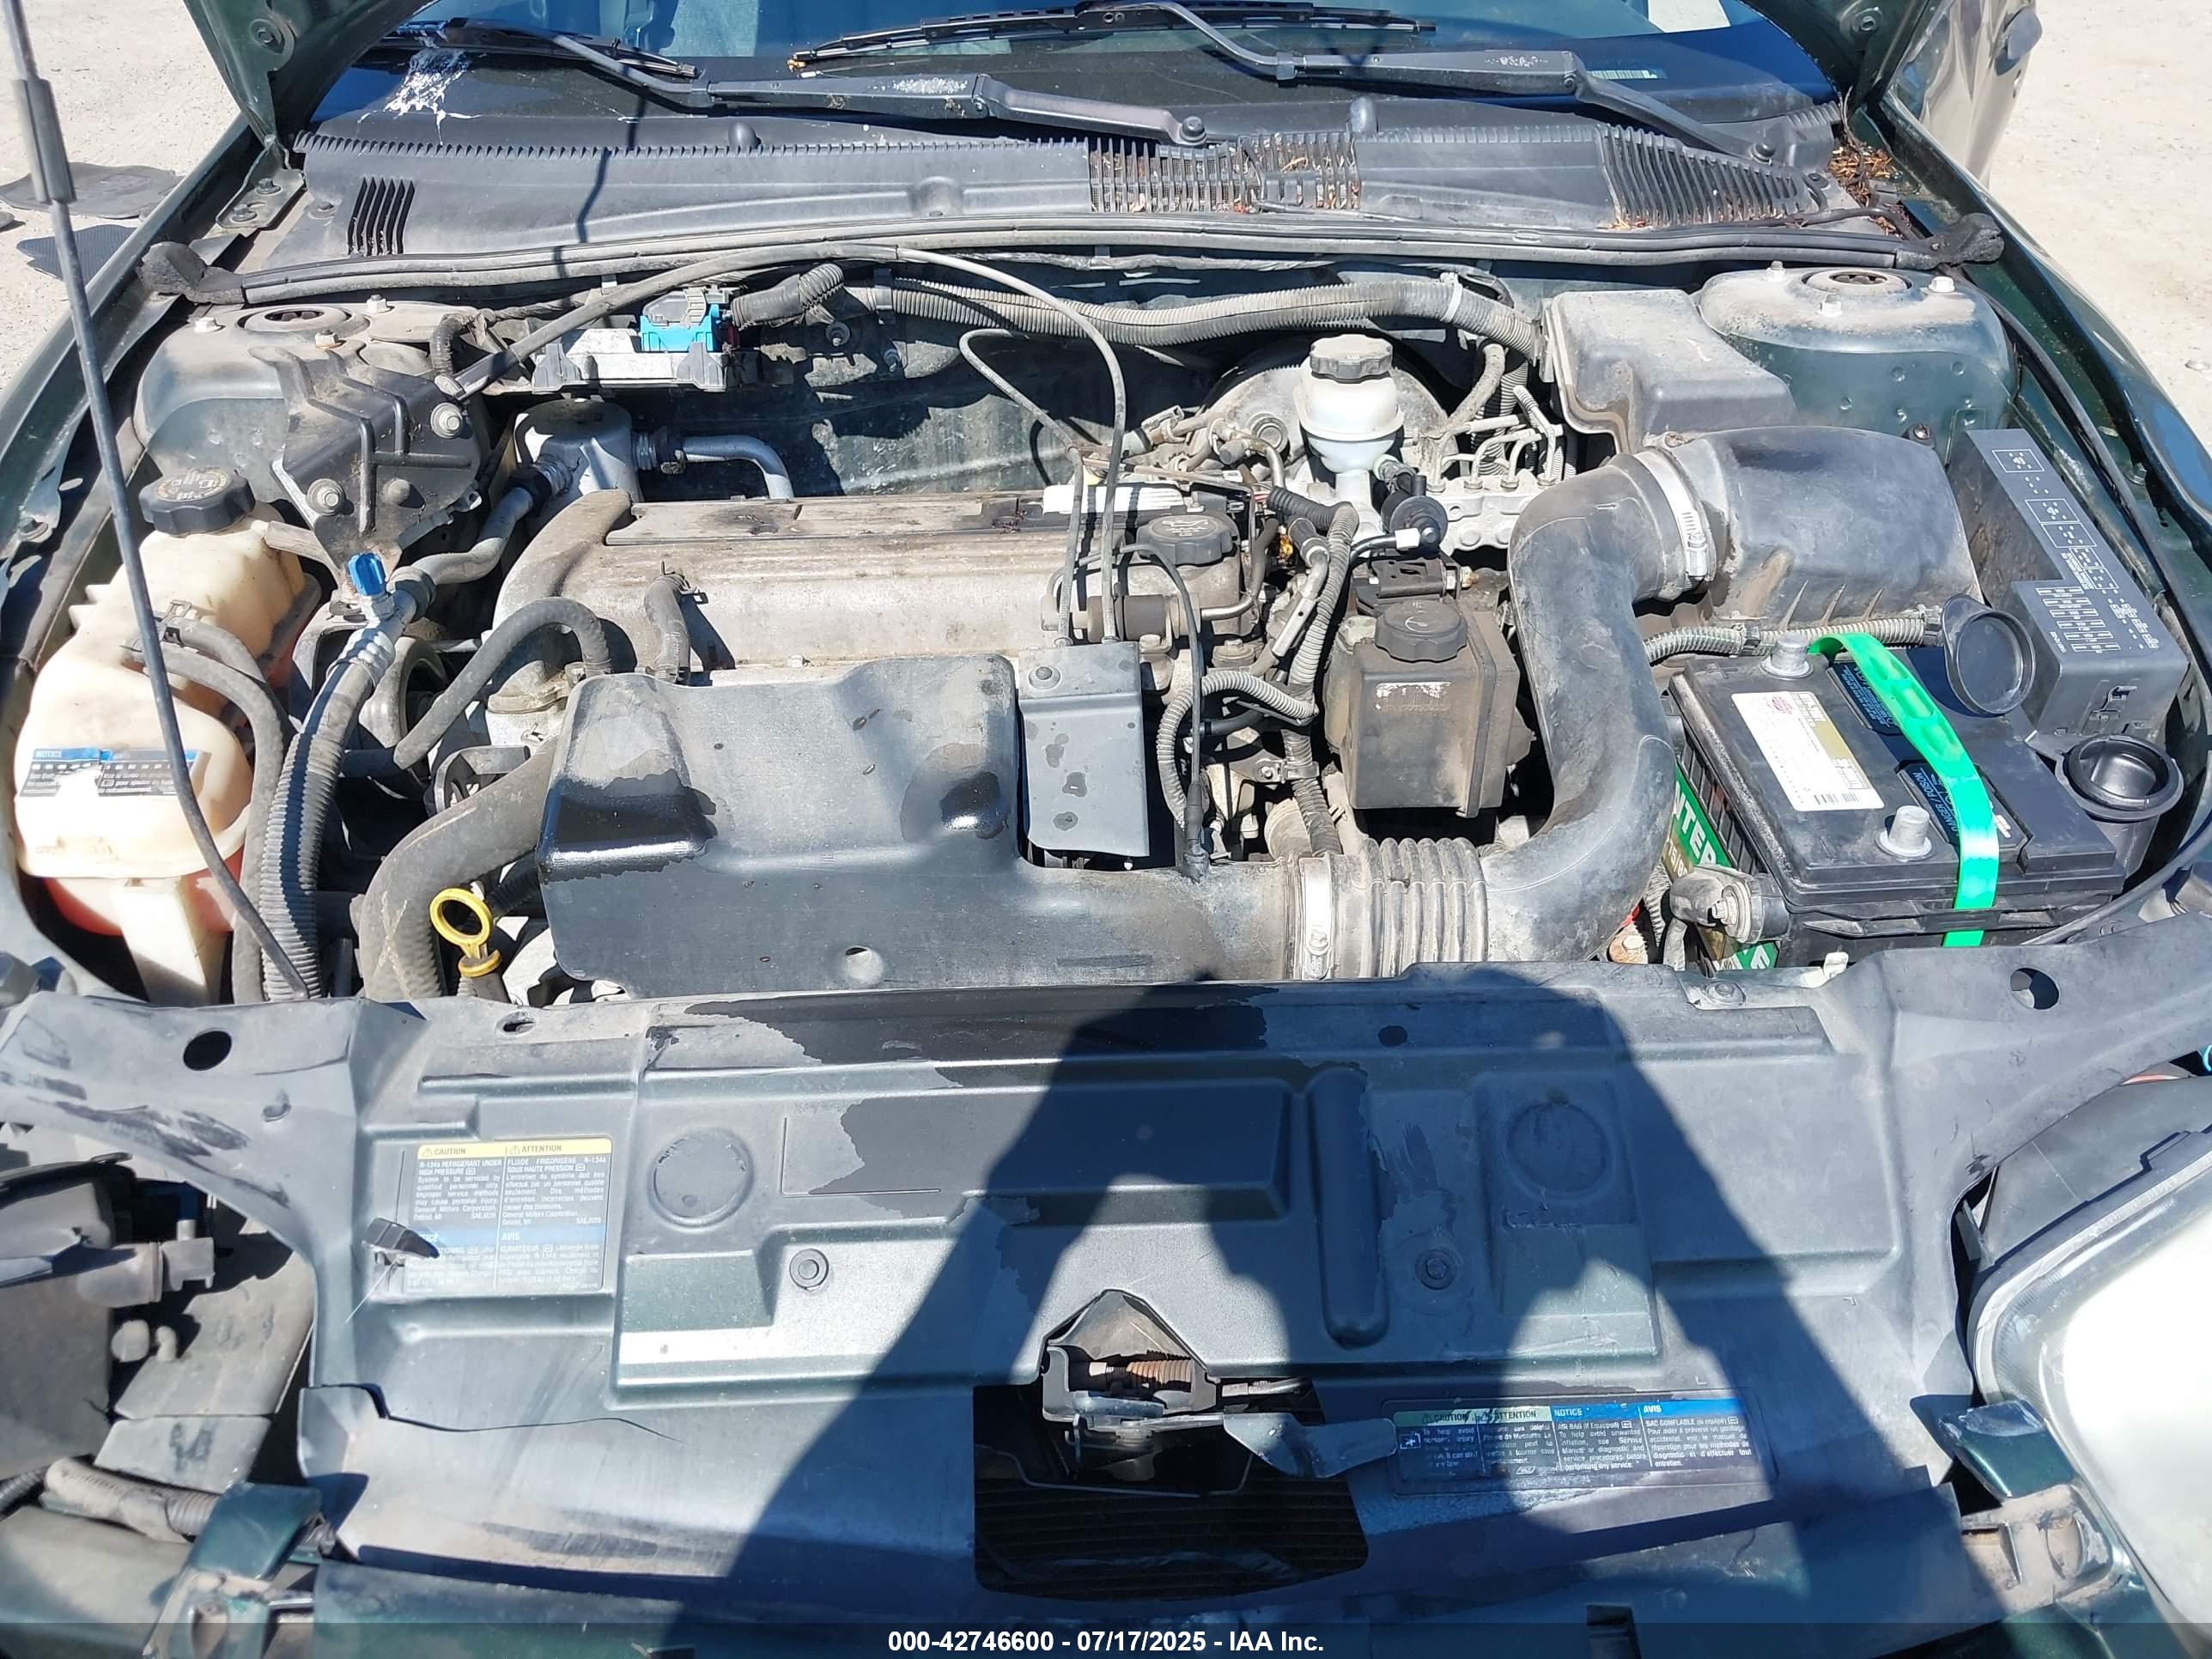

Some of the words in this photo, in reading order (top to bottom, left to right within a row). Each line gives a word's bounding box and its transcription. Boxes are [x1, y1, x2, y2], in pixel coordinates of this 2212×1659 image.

[1913, 772, 1936, 799] POISON
[501, 1231, 520, 1240] AVIS
[1554, 1408, 1583, 1417] NOTICE
[1644, 1405, 1662, 1413] AVIS
[1496, 1411, 1536, 1420] ATTENTION
